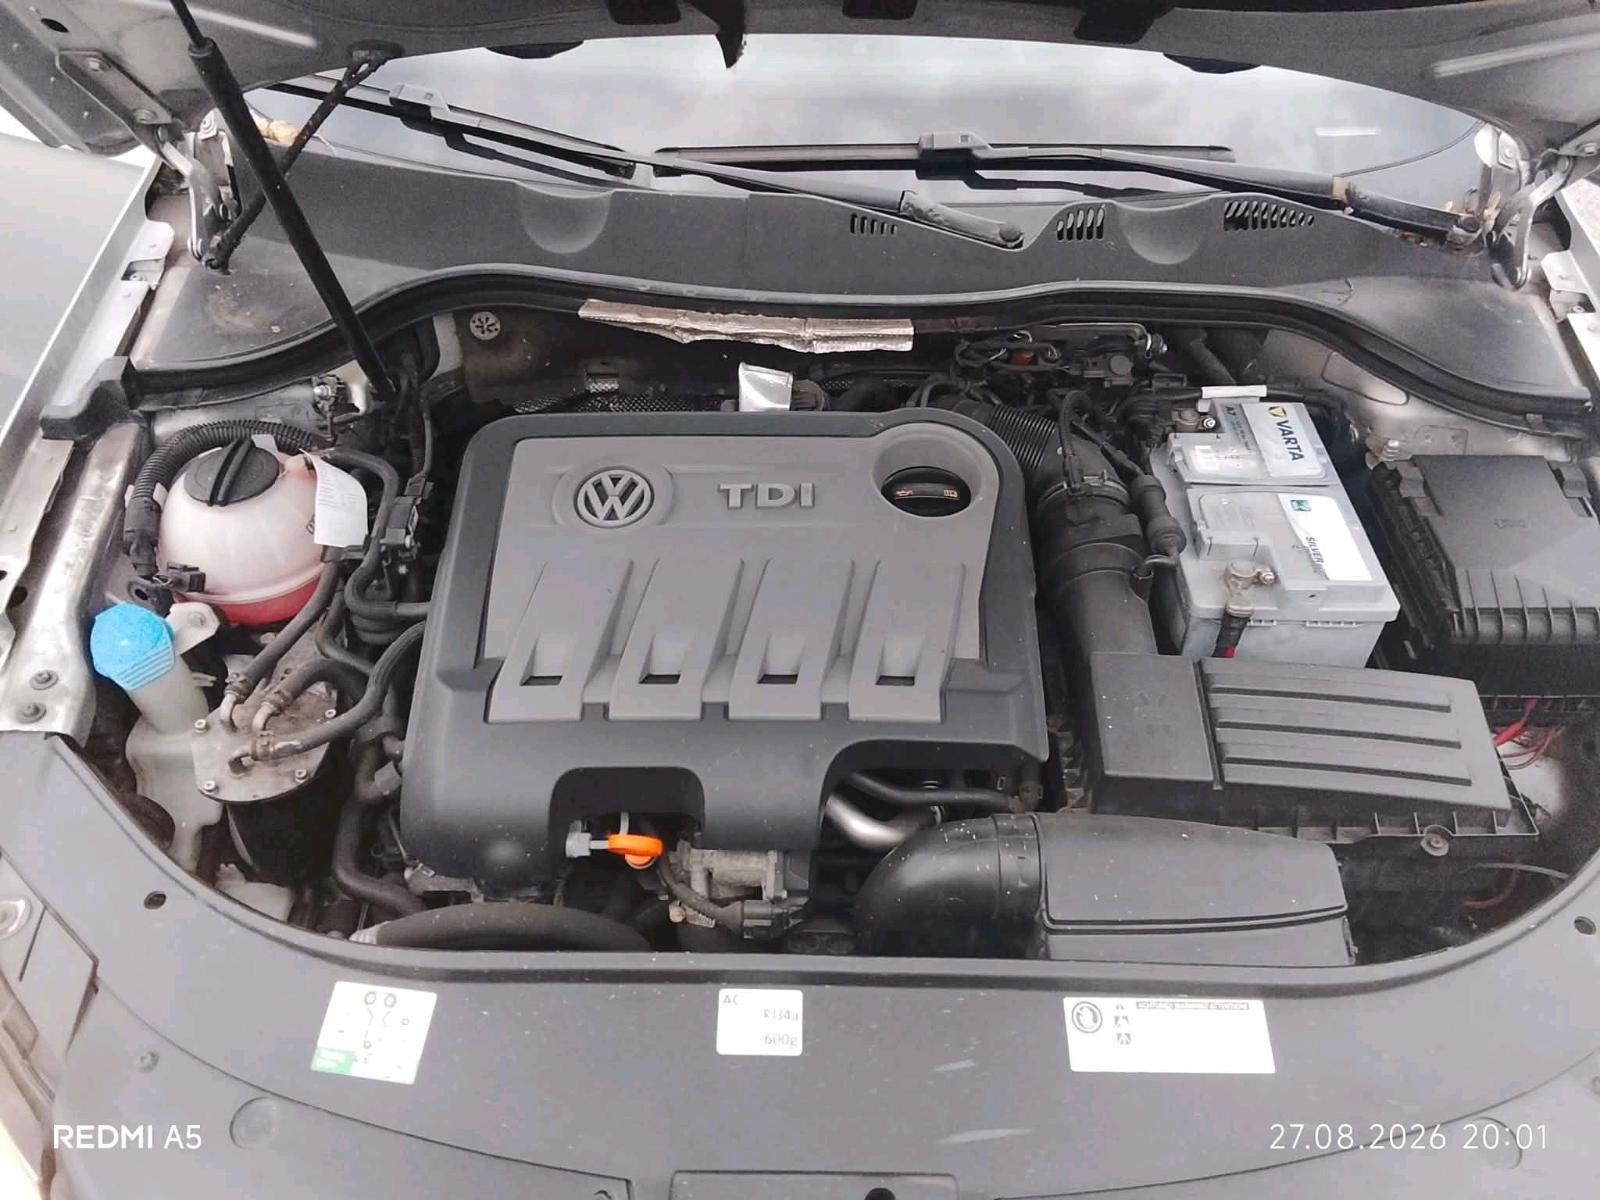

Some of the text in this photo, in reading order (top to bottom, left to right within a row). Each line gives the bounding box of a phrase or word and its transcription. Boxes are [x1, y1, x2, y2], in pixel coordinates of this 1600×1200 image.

[1276, 420, 1304, 461] VARTA
[576, 469, 652, 527] VW
[718, 483, 815, 509] TDI
[1306, 537, 1324, 563] SILVER
[764, 1033, 798, 1049] 600g
